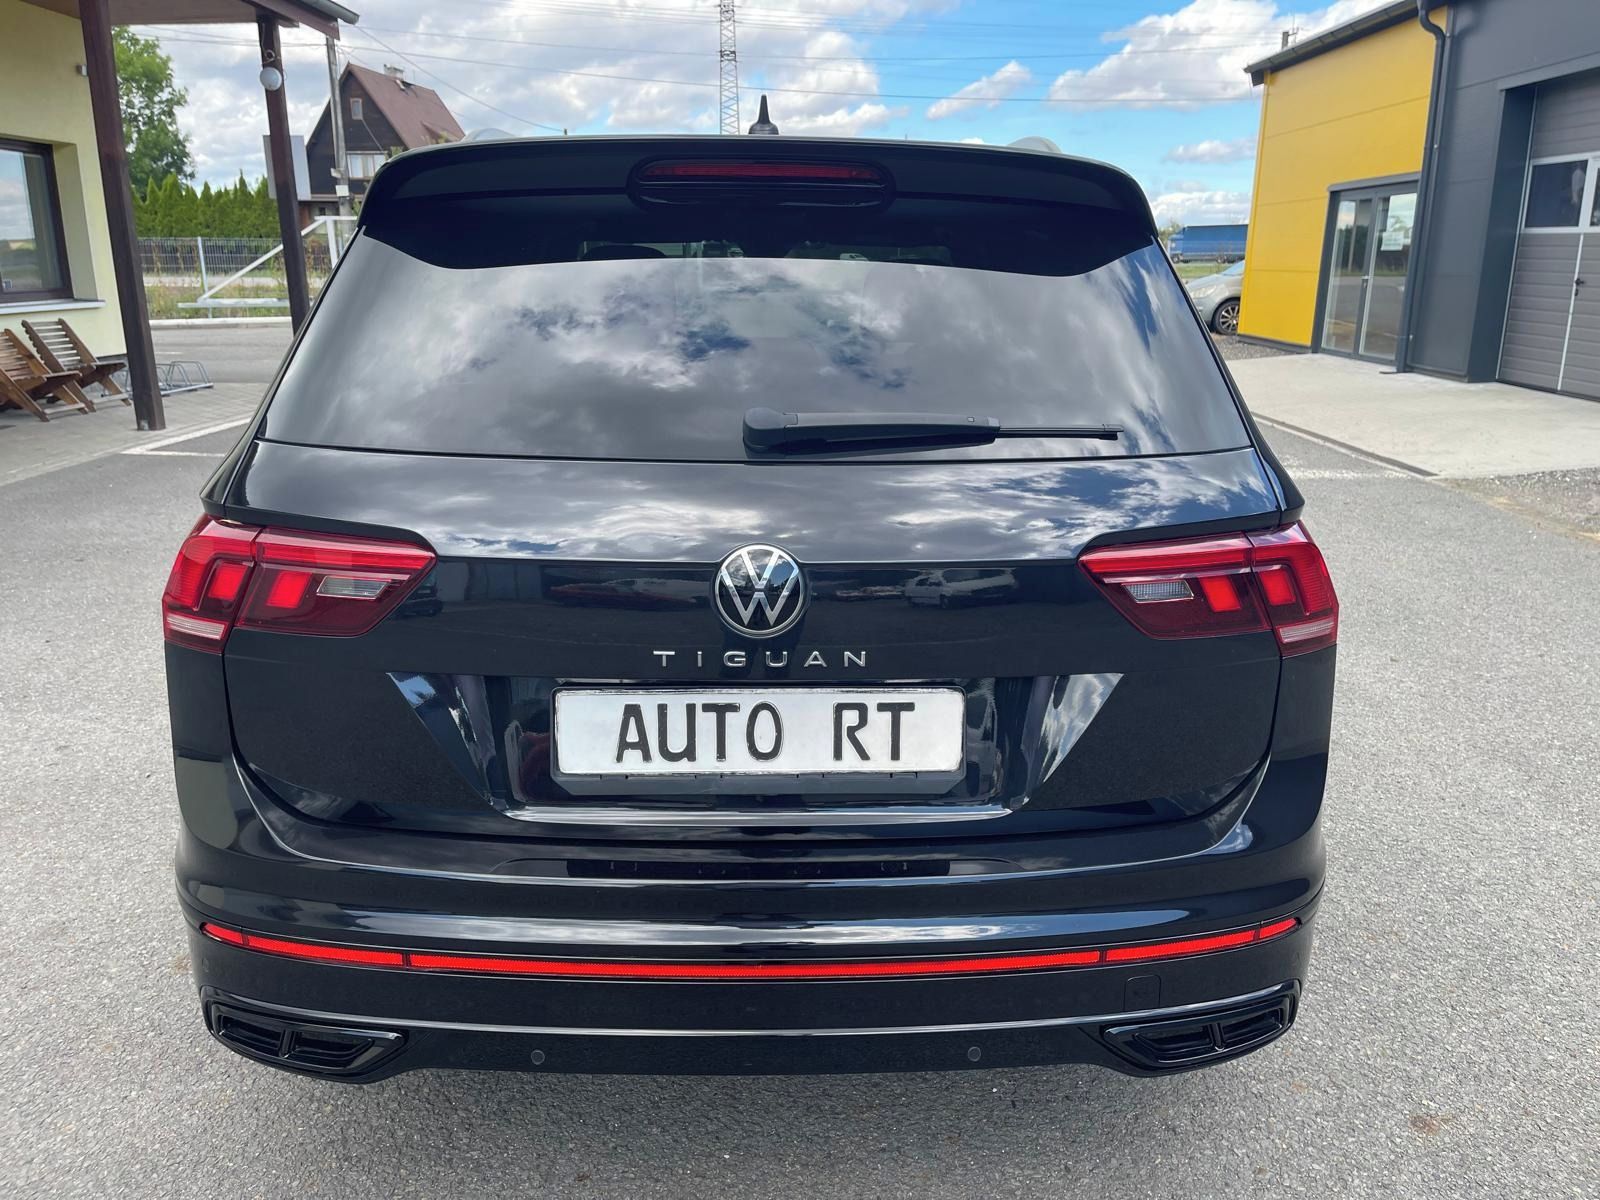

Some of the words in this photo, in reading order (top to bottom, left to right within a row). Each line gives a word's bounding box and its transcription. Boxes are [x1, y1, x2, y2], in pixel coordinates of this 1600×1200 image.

[718, 546, 801, 628] VW
[653, 650, 867, 668] TIGUAN
[615, 701, 784, 763] AUTO
[832, 701, 916, 761] RT
